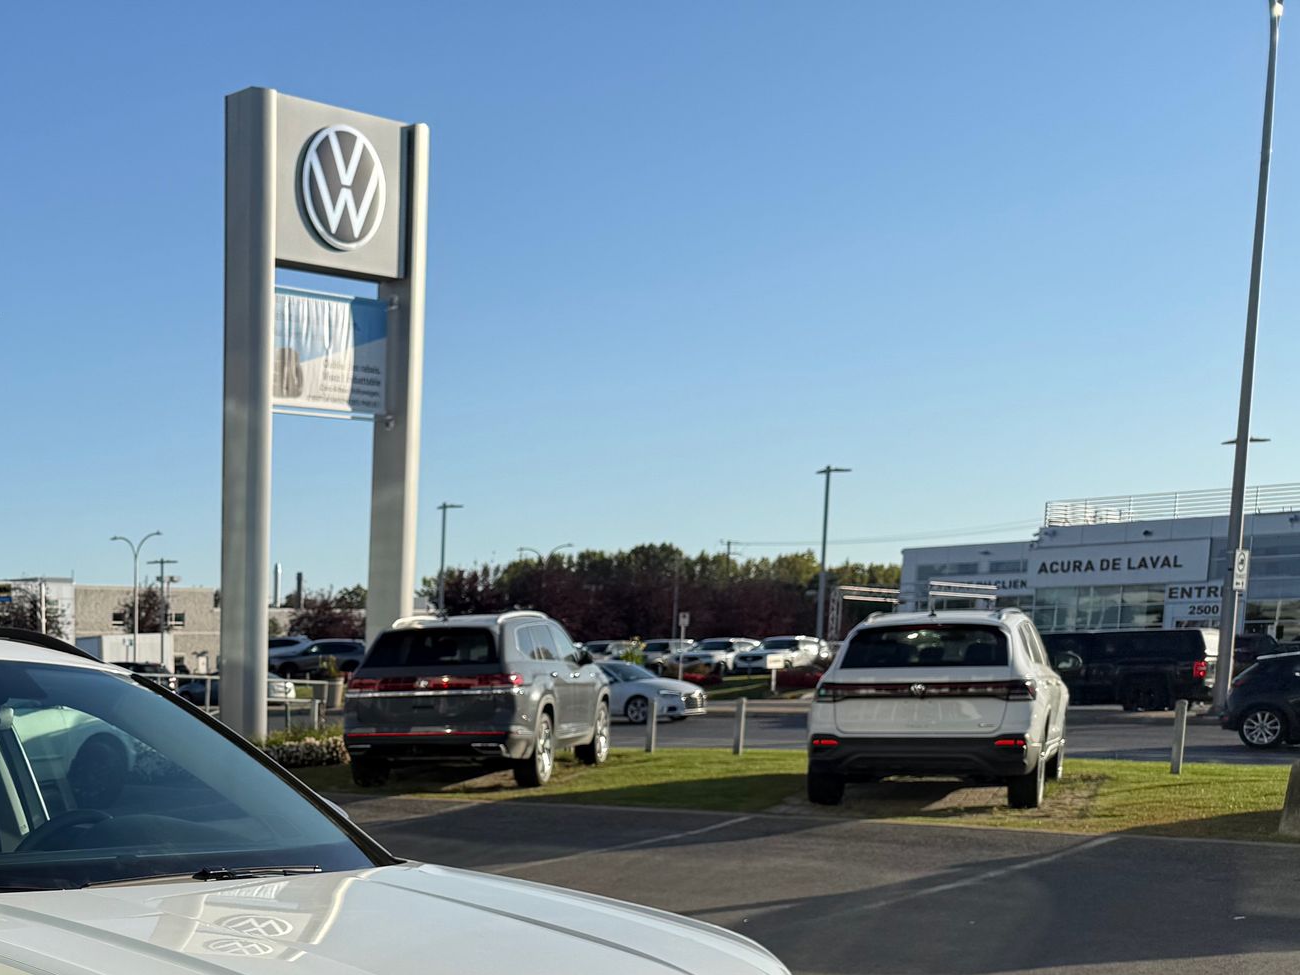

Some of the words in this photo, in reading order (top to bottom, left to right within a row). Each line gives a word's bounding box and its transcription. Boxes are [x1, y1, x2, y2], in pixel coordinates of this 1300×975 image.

[1037, 559, 1095, 575] ACURA
[1100, 557, 1122, 571] DE
[1127, 554, 1183, 570] LAVAL
[1168, 585, 1224, 599] ENTR
[1188, 604, 1219, 615] 2500
